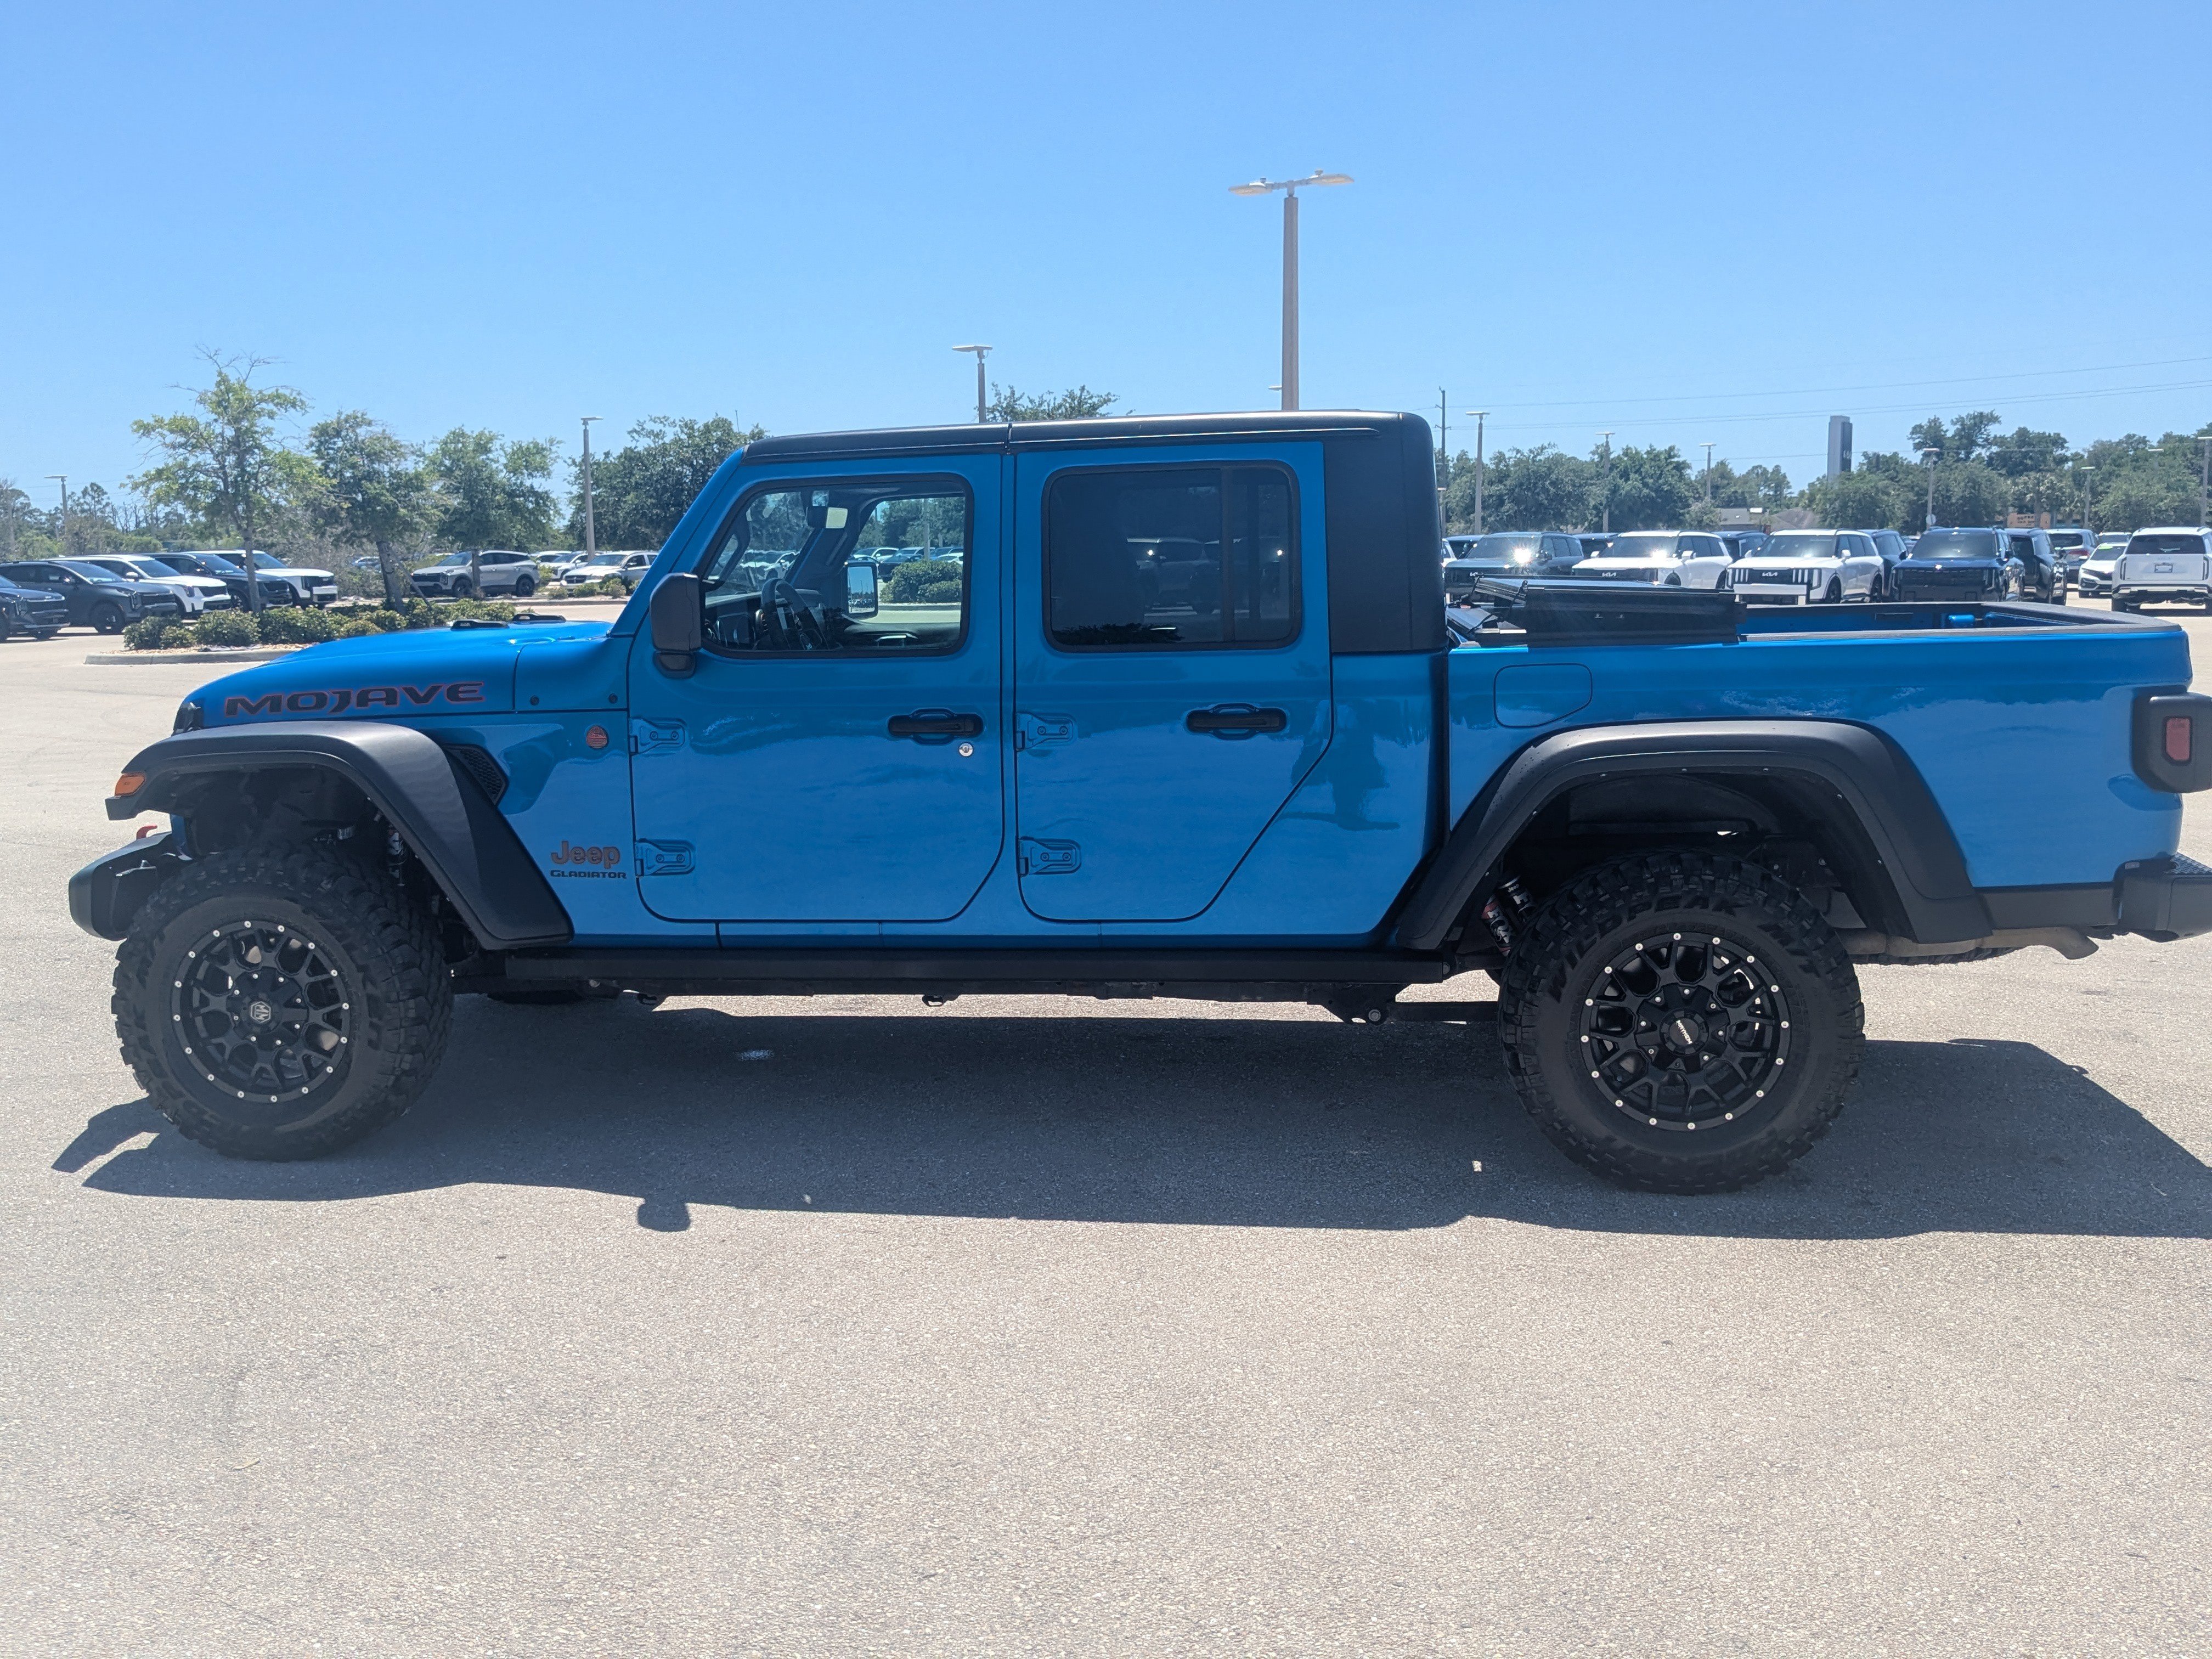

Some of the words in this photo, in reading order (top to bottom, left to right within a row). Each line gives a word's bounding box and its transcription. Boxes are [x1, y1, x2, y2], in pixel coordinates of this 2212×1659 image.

[225, 682, 484, 716] MOJAVE
[551, 840, 620, 869] Jeep
[550, 870, 627, 879] GLADIATOR
[1675, 1020, 1692, 1045] MAYHEM
